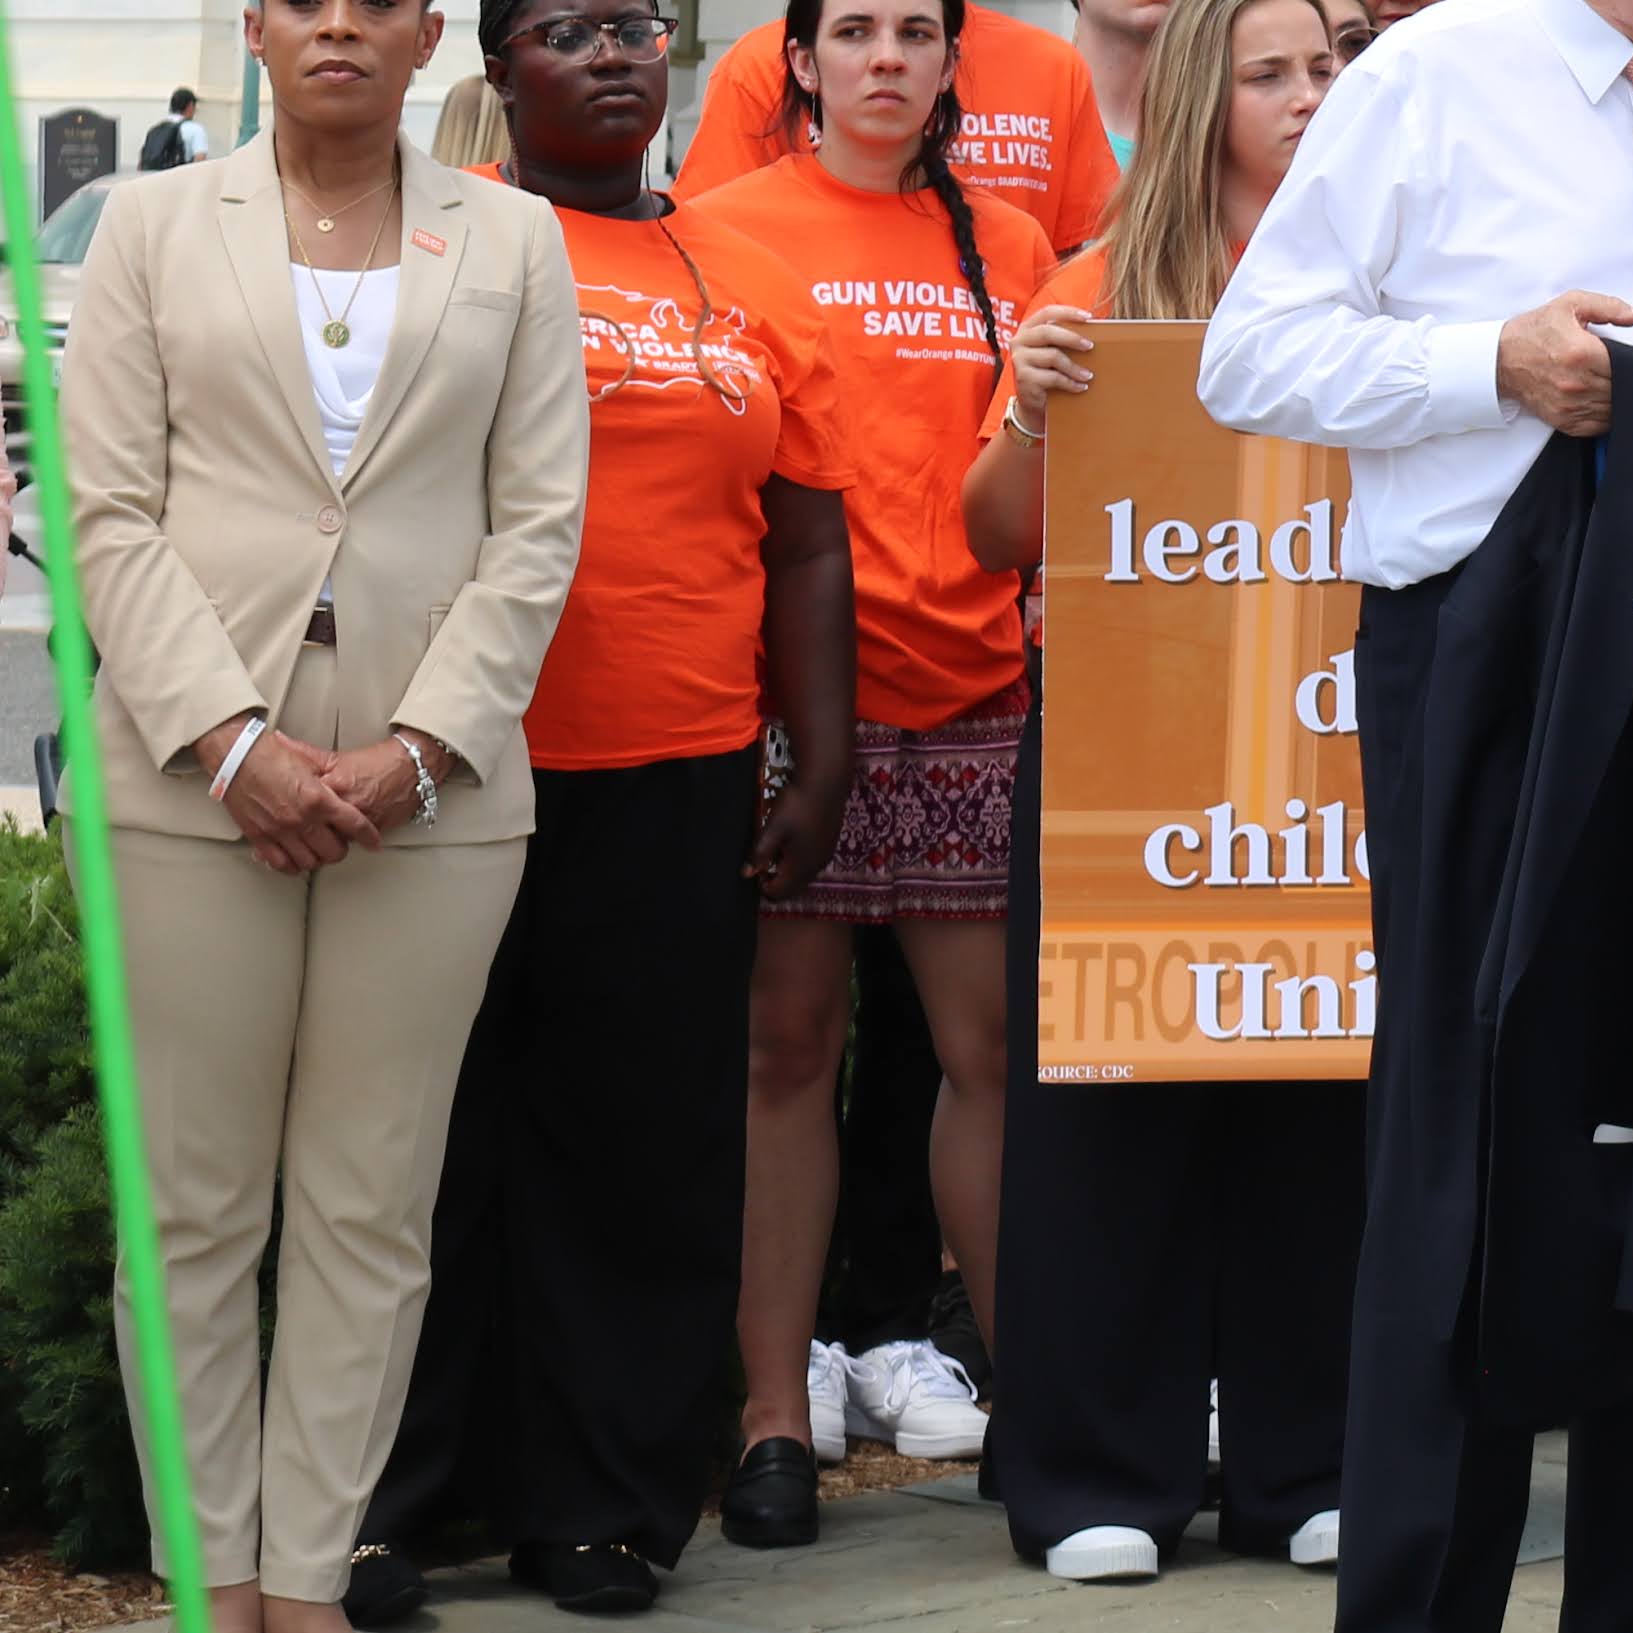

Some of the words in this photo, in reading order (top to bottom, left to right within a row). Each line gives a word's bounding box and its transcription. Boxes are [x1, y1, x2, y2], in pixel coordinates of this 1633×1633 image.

[961, 112, 1053, 143] OLENCE.
[992, 142, 1052, 171] LIVES.
[811, 281, 876, 306] GUN
[863, 310, 942, 336] SAVE
[950, 315, 1013, 351] LIVS
[1104, 498, 1346, 583] lead
[1101, 1065, 1134, 1079] CDC
